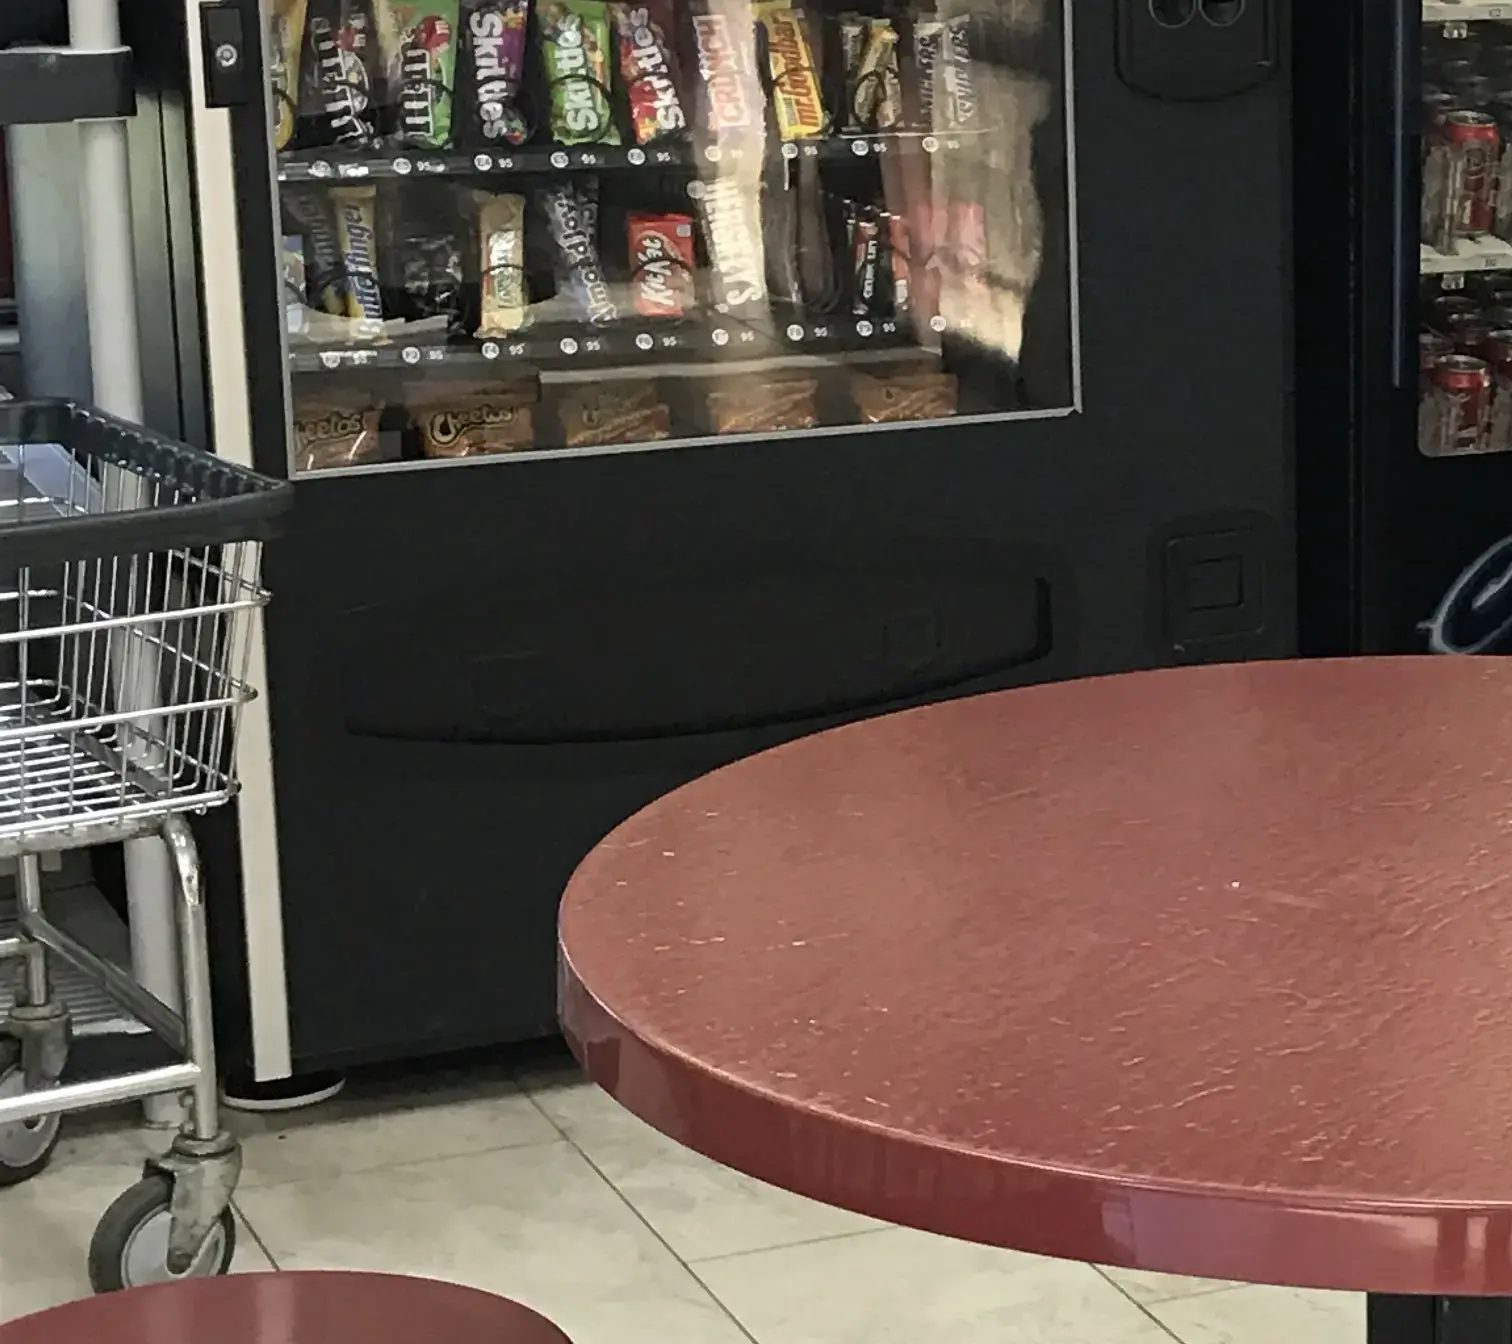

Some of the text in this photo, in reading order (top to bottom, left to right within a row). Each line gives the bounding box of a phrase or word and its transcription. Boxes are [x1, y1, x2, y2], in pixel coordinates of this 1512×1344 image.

[469, 9, 509, 141] Skittles
[555, 15, 599, 132] Skittles
[629, 6, 687, 132] Skittles
[696, 16, 747, 124] CRUNCH
[430, 403, 518, 446] Cheetos
